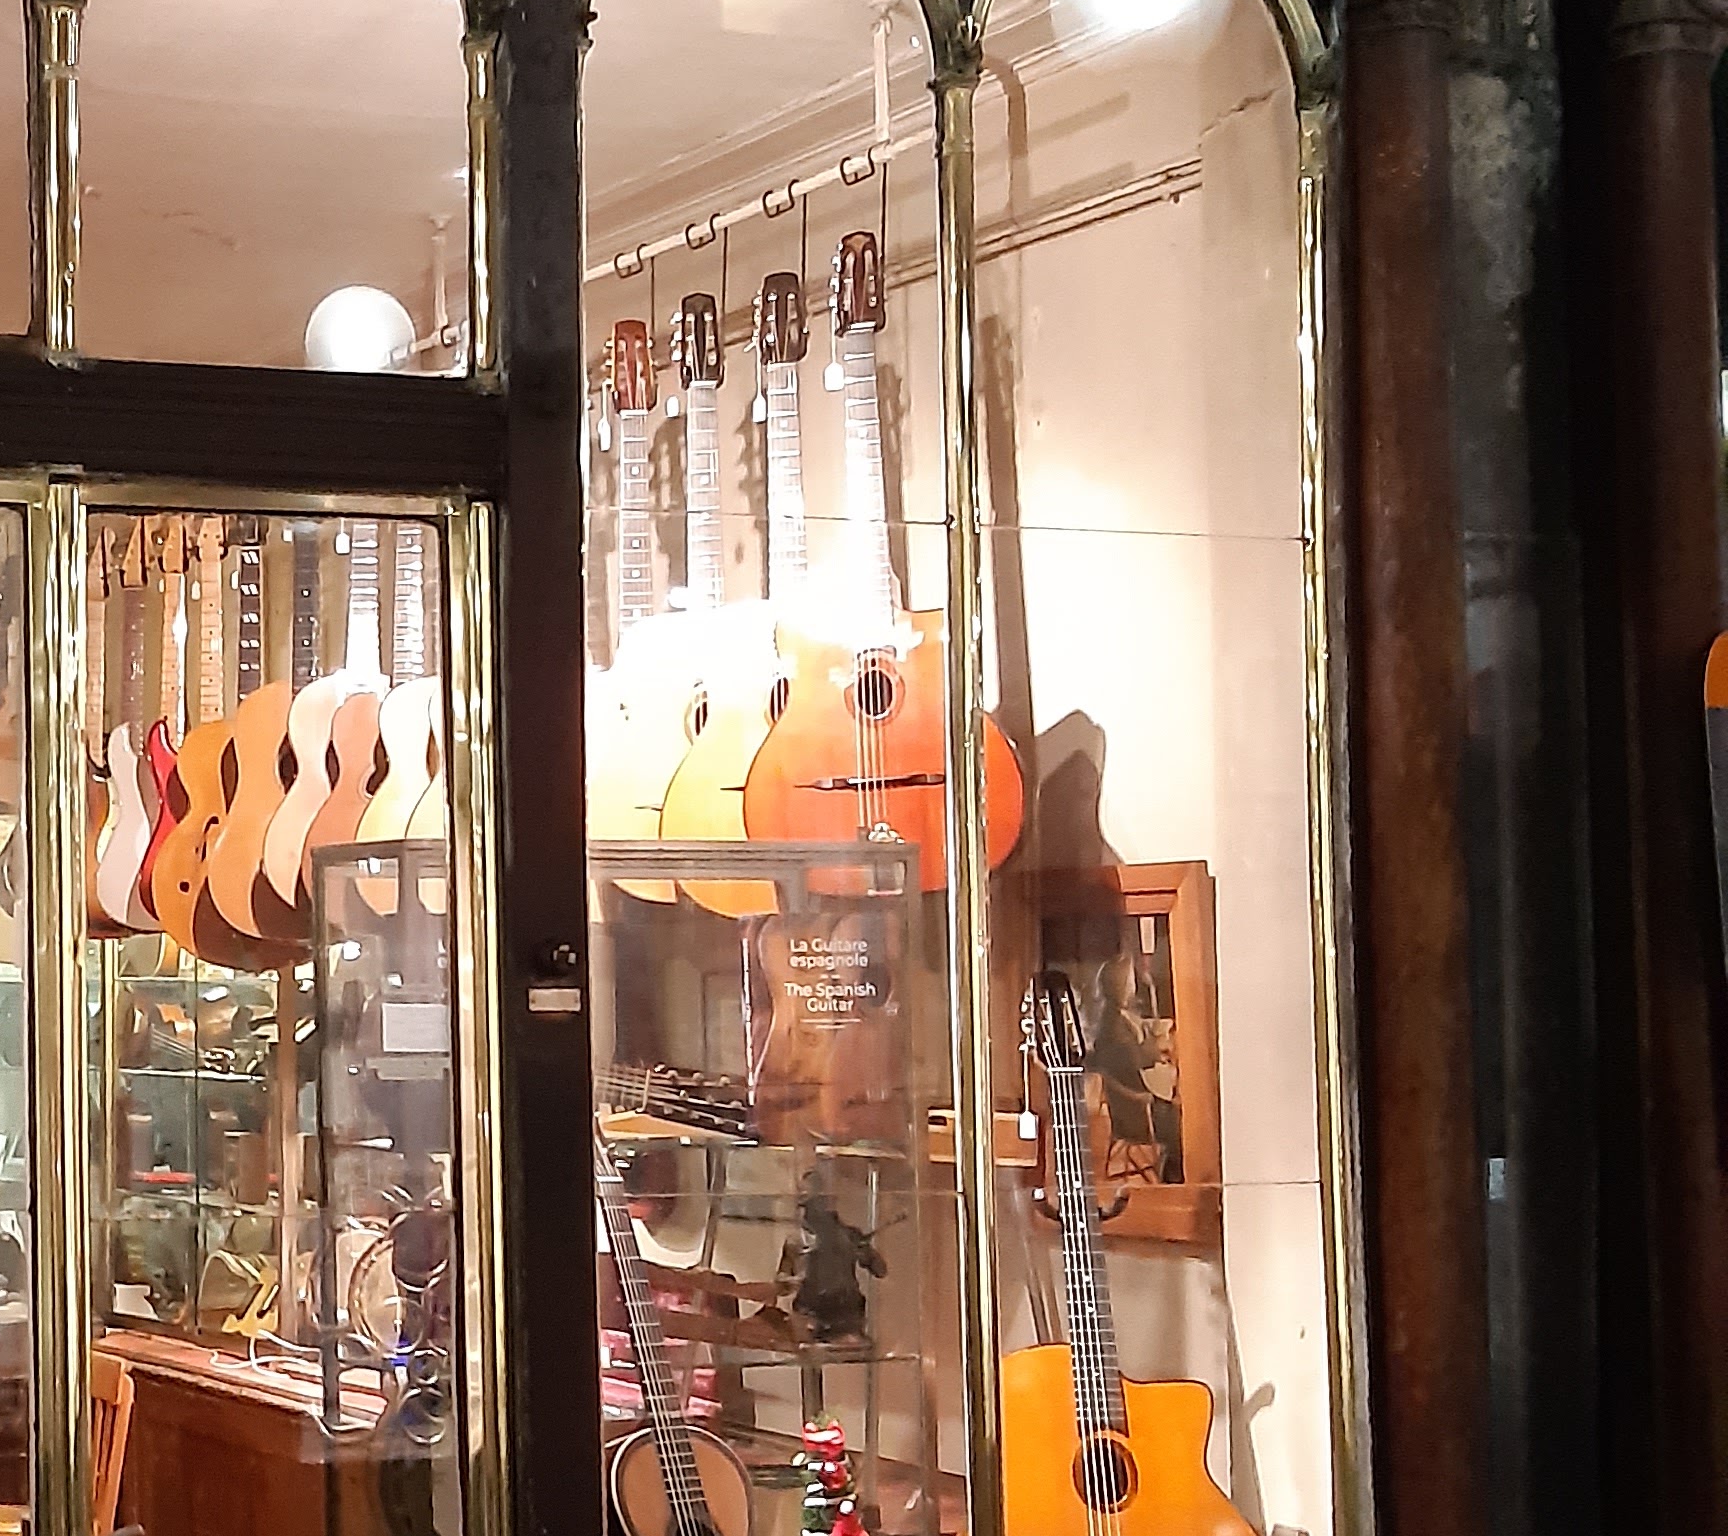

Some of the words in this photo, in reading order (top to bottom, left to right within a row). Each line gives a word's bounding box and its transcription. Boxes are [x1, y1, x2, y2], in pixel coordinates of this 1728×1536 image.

[789, 938, 808, 953] La
[811, 937, 868, 953] Guitare
[789, 952, 869, 971] espagnole
[783, 982, 812, 997] The
[815, 981, 877, 1000] Spanish
[806, 997, 854, 1013] Guitar
